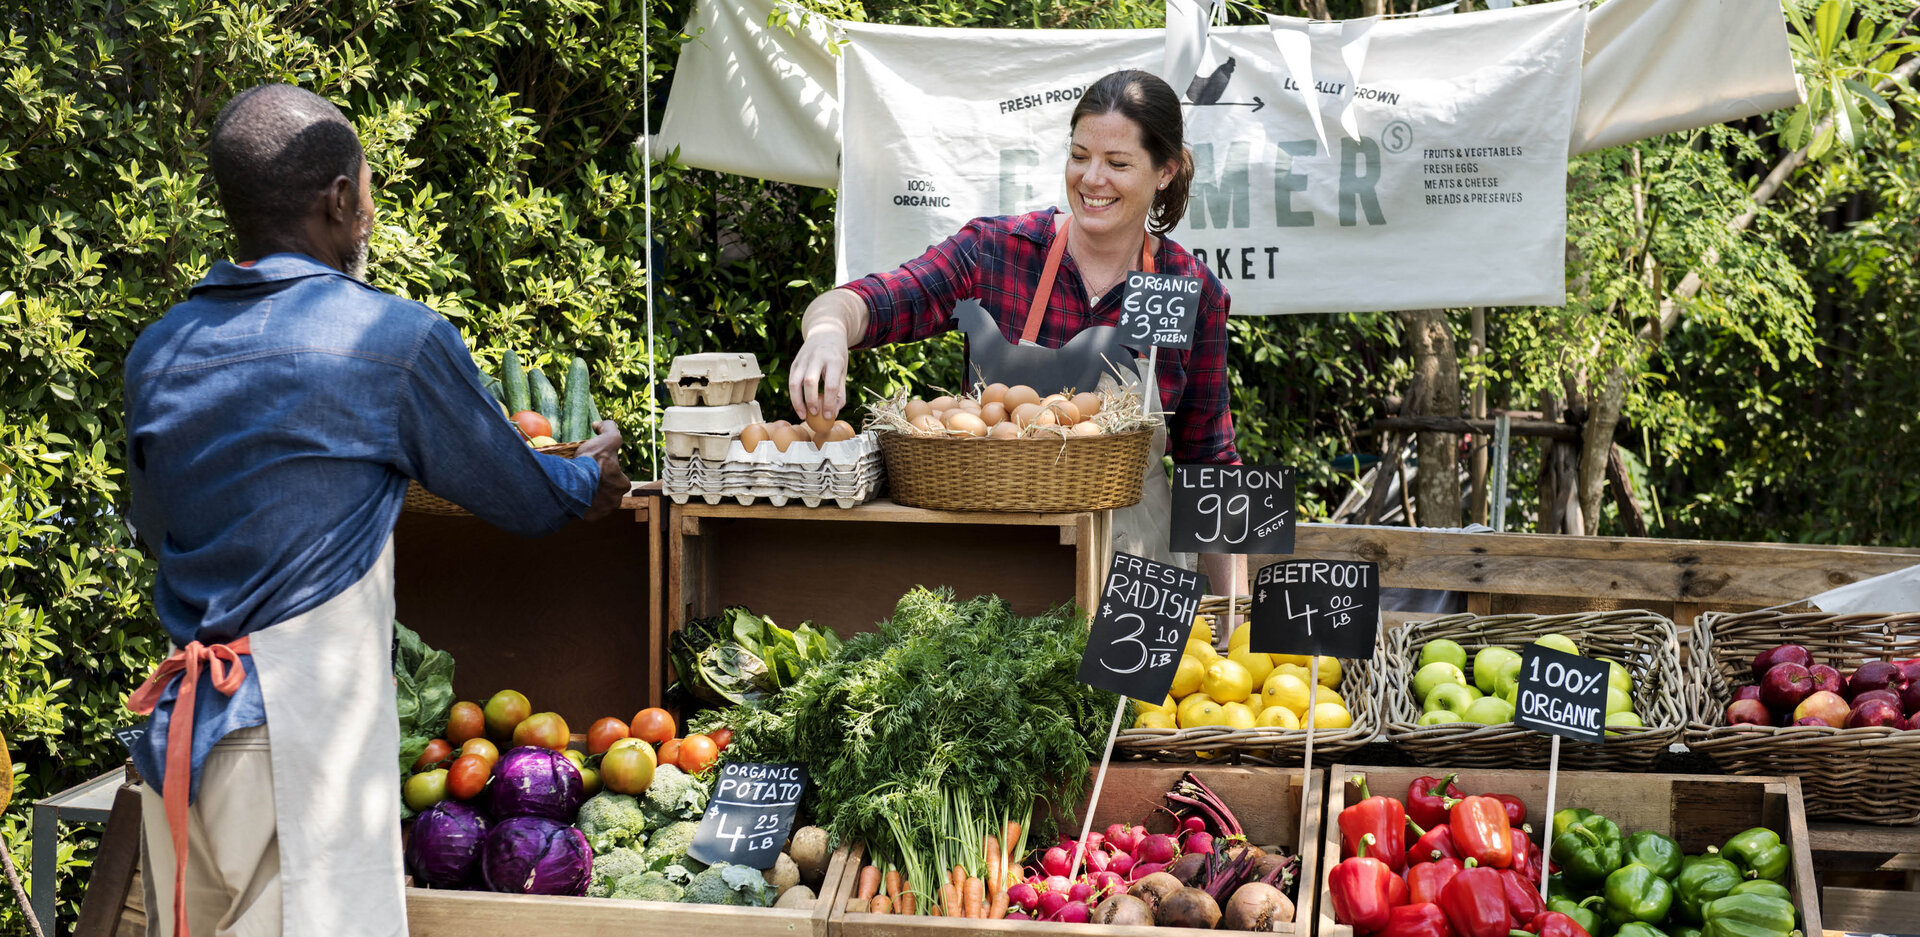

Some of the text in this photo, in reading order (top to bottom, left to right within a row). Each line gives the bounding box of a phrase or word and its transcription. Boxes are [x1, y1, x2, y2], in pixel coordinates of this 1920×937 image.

[1284, 77, 1346, 95] LALLY
[999, 85, 1086, 114] FRESH PROD
[1423, 146, 1523, 159] FRUITS & VEGETABLES
[1423, 163, 1479, 174] FRESH EGGS
[907, 180, 936, 192] 100%
[999, 135, 1388, 229] FMER
[1424, 177, 1499, 189] MEATS & CHEESE
[893, 195, 951, 208] ORGANIC
[1425, 192, 1523, 205] BREADS & PRESERVES
[1128, 275, 1198, 294] ORGANIC
[1124, 291, 1185, 317] EGG
[1152, 333, 1188, 345] DOZEN
[1194, 493, 1250, 544] 99
[1257, 518, 1285, 538] EACH
[1114, 555, 1197, 591] FRESH
[1258, 562, 1370, 588] BEETROOT
[1106, 573, 1198, 627] RADISH
[1332, 612, 1351, 629] LB
[1149, 653, 1172, 669] LB
[1529, 655, 1603, 696] 100%
[1521, 689, 1601, 730] ORGANIC
[726, 764, 799, 780] ORGANIC
[717, 779, 802, 801] POTATO
[748, 836, 774, 851] LB
